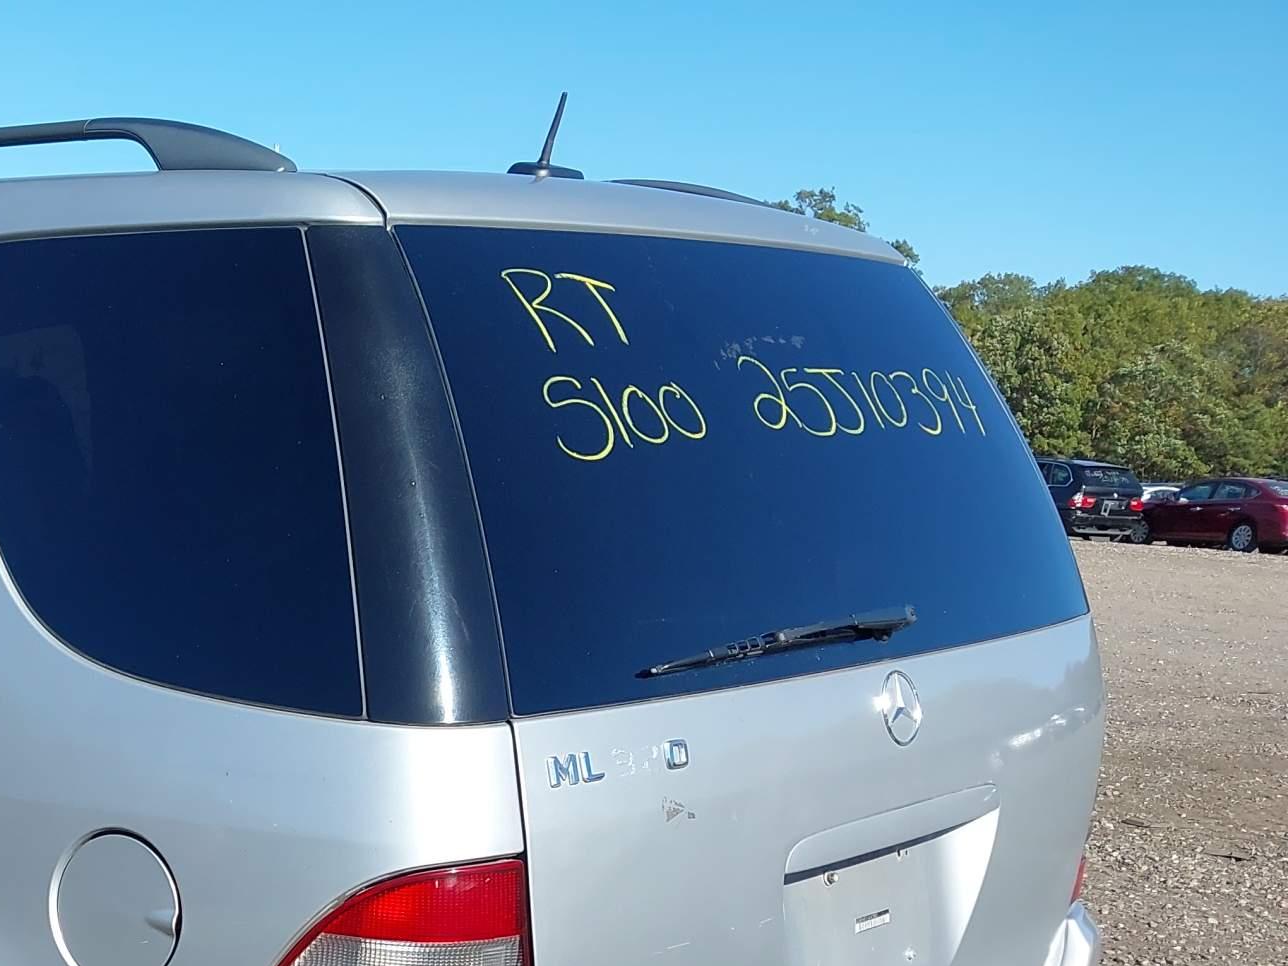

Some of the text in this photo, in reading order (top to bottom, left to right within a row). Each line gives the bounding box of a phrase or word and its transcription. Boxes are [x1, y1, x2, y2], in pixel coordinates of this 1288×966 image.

[501, 268, 629, 353] RT
[737, 356, 987, 437] 25J10394
[547, 752, 606, 788] ML
